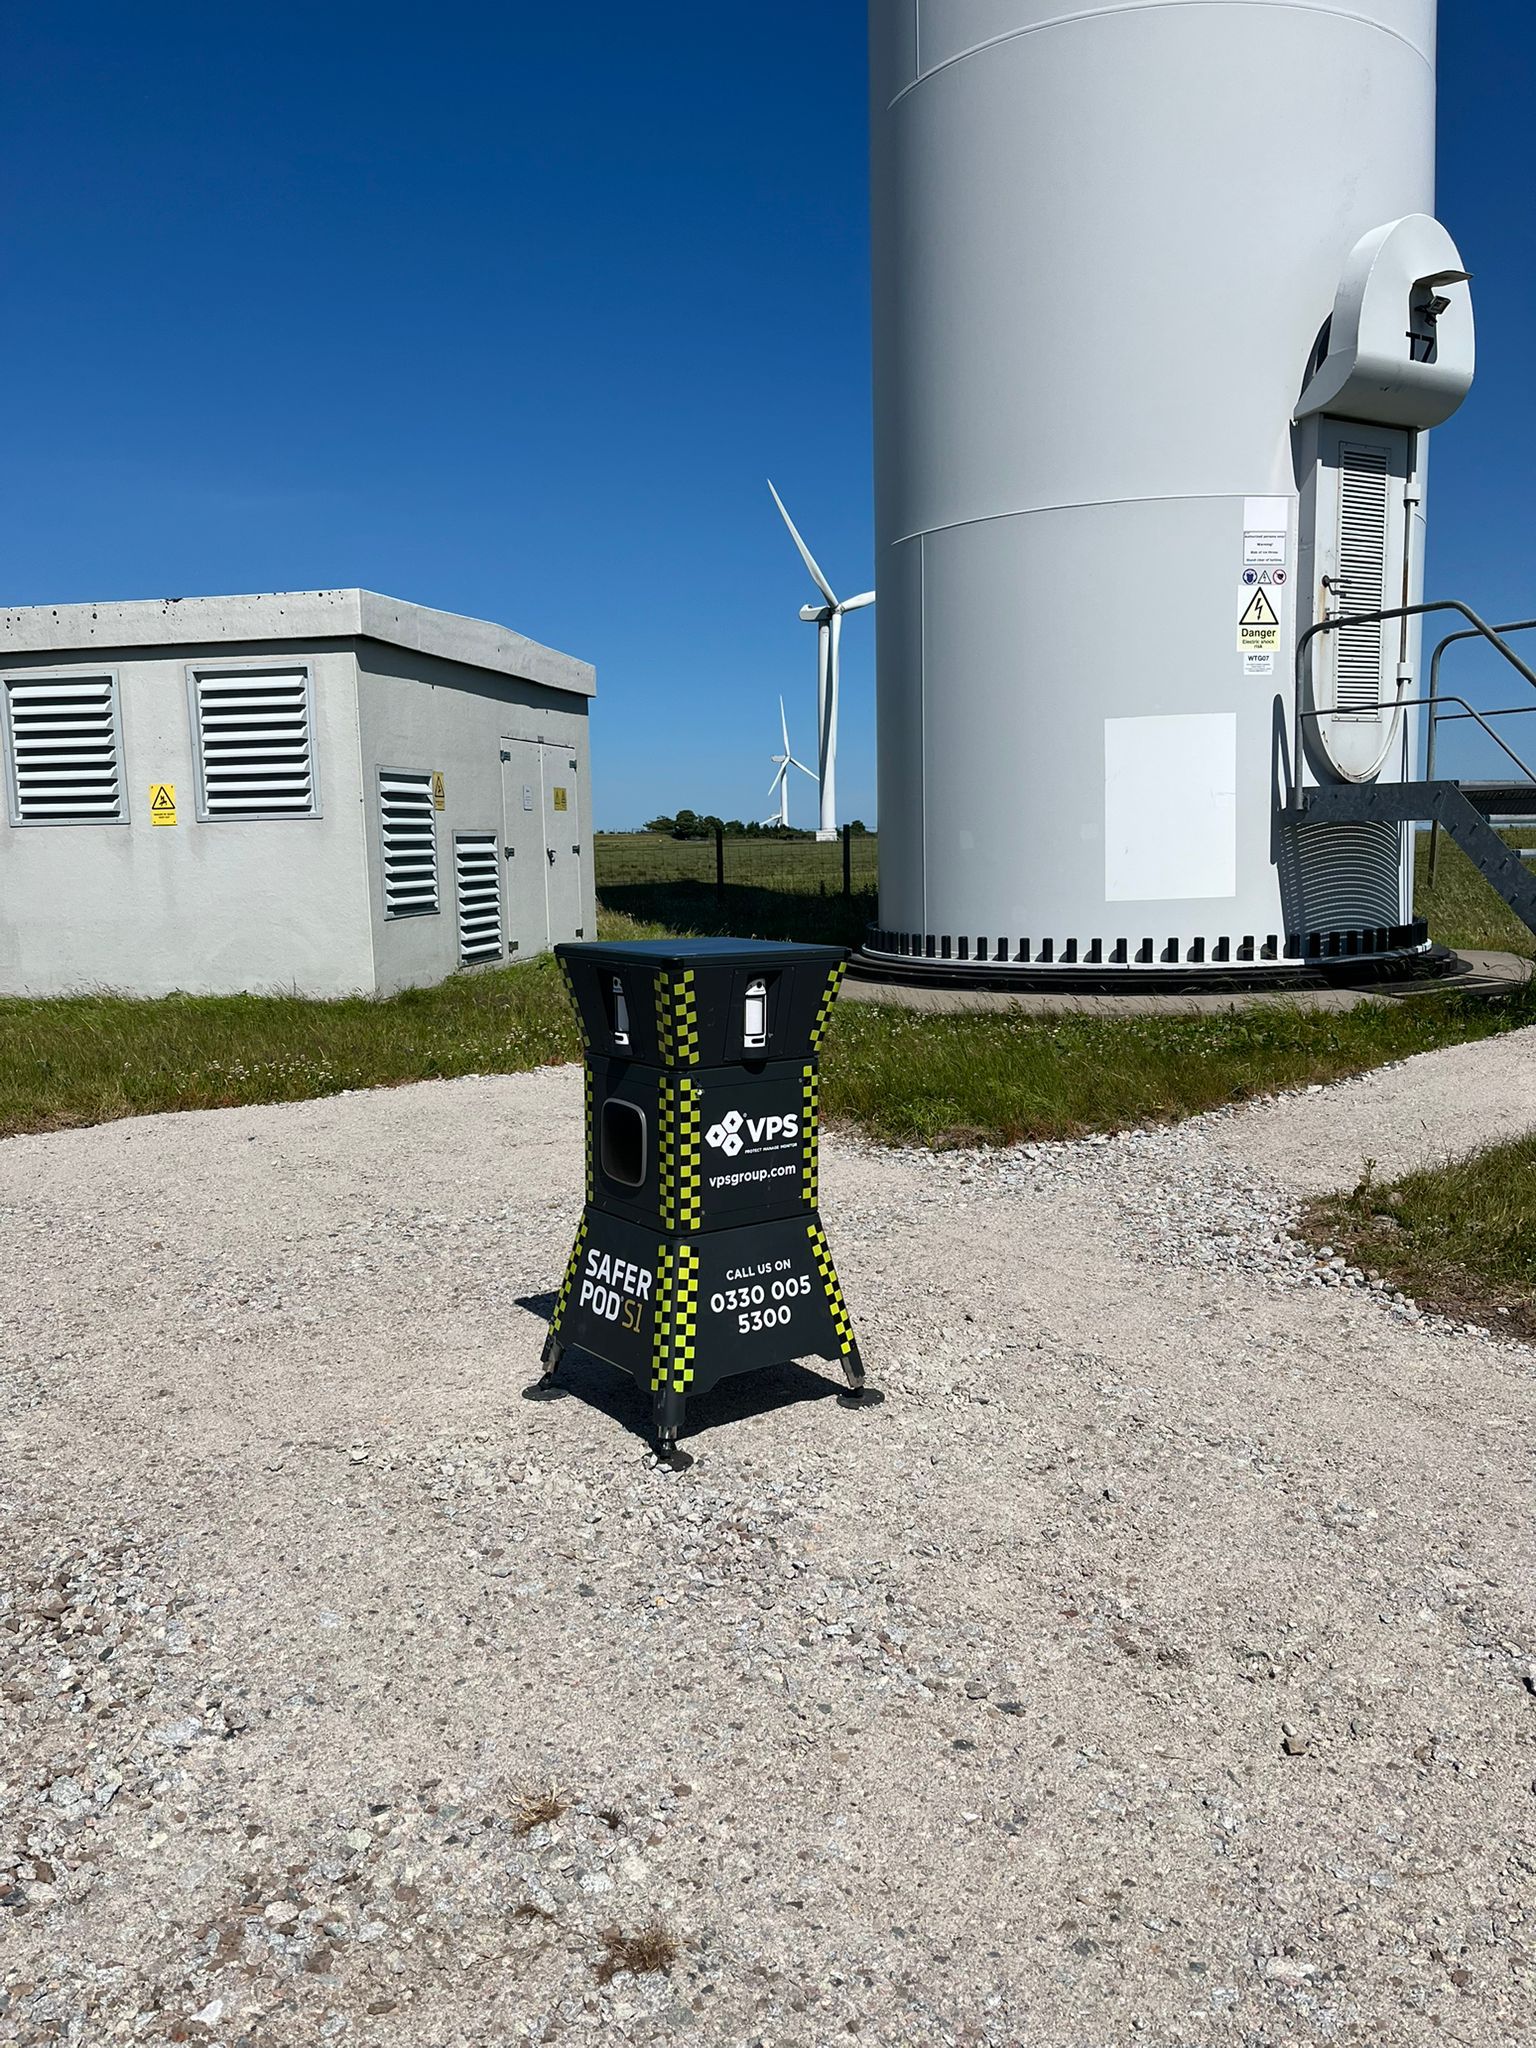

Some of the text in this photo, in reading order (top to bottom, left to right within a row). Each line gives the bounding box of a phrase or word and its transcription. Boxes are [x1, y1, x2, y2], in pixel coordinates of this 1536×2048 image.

[1241, 628, 1276, 639] Danger
[745, 1113, 799, 1143] VPS
[708, 1164, 796, 1188] vpsgroup.com
[585, 1248, 653, 1301] SAFER
[726, 1258, 791, 1280] CALL US ON
[710, 1274, 811, 1313] 0330 005
[738, 1305, 791, 1334] 5300
